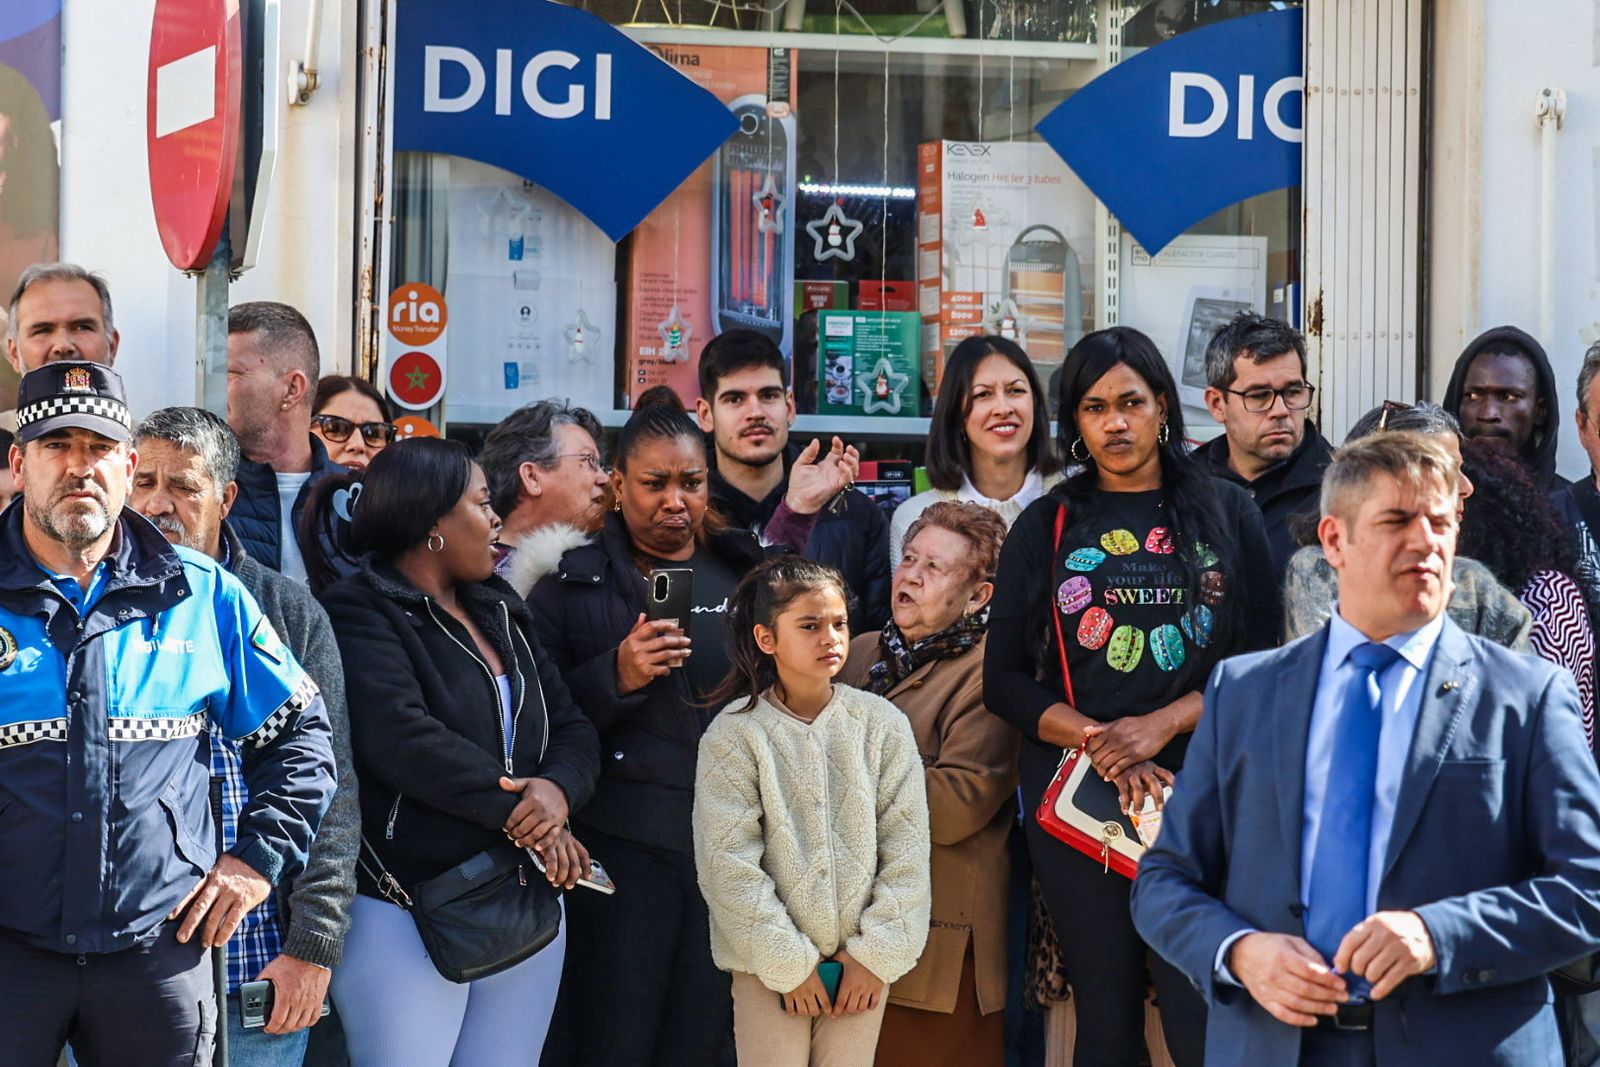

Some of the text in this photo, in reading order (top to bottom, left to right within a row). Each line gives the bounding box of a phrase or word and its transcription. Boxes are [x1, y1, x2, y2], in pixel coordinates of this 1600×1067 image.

[424, 45, 612, 120] DIGI
[948, 171, 989, 183] Halogen
[1026, 175, 1033, 185] 3
[1034, 175, 1062, 185] tubes
[393, 290, 440, 323] ria
[393, 325, 439, 334] Money Transfer
[1107, 575, 1146, 588] your
[1104, 588, 1186, 605] SWEET
